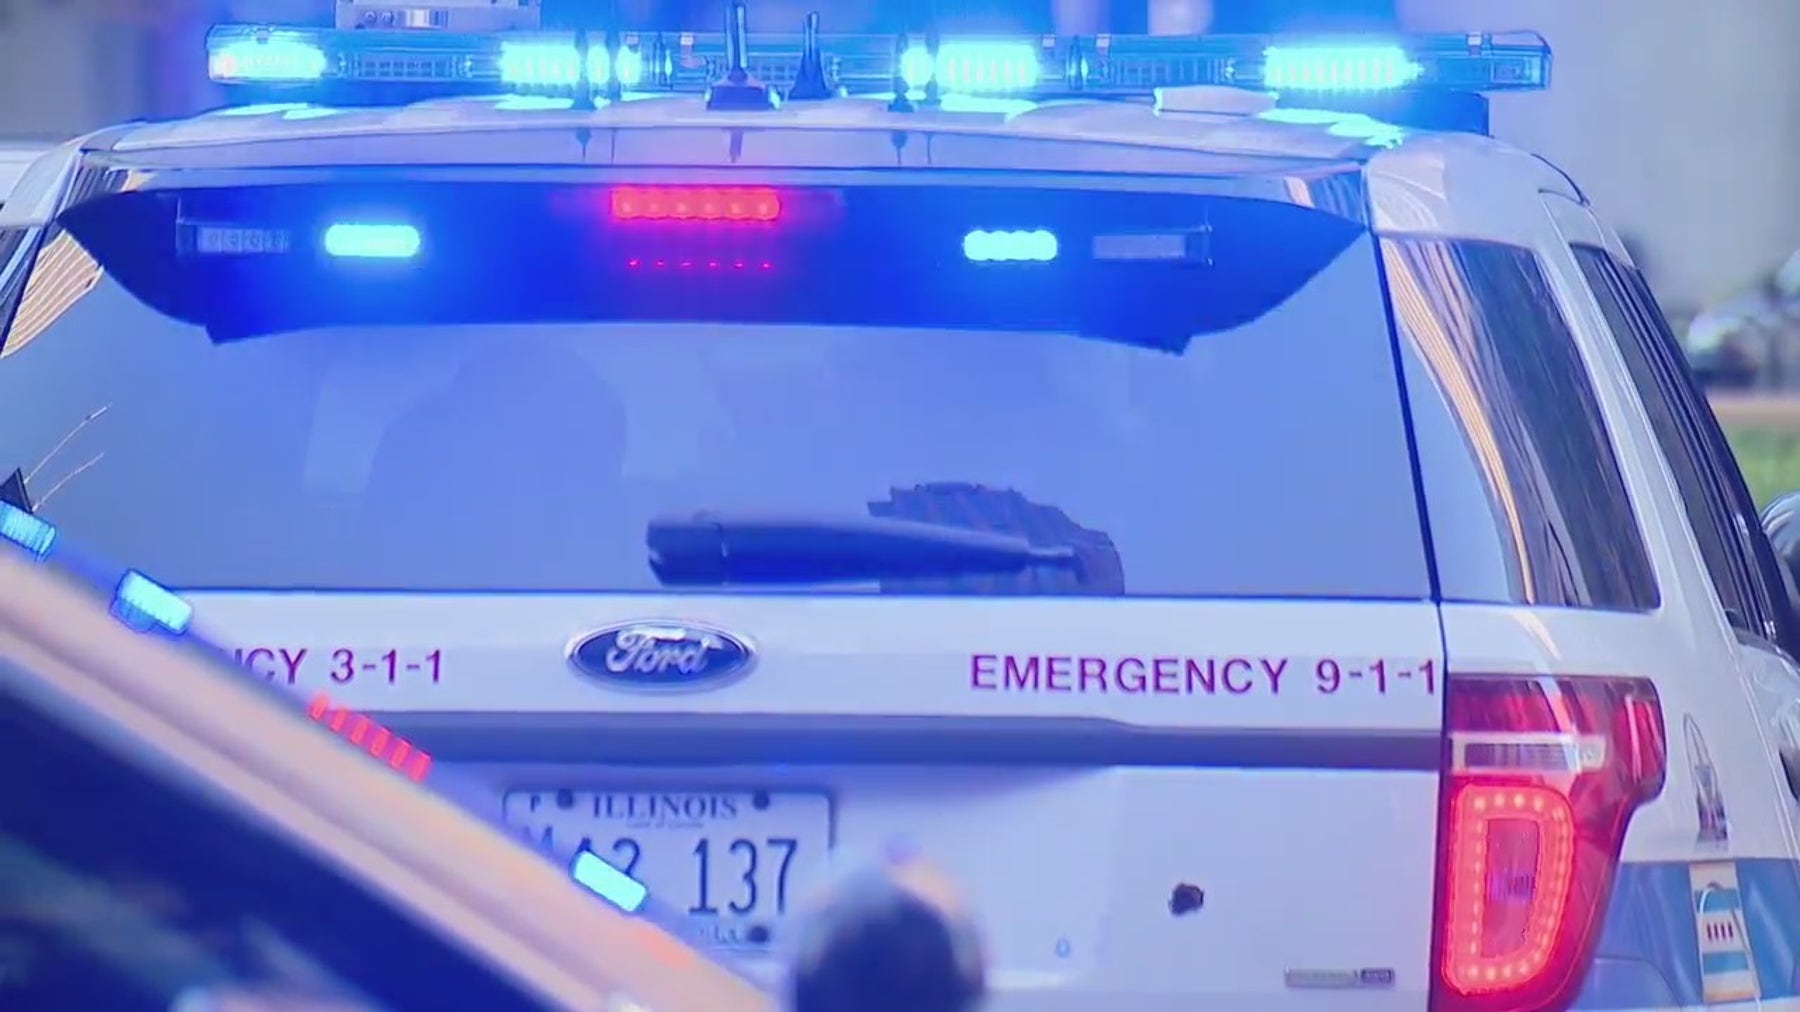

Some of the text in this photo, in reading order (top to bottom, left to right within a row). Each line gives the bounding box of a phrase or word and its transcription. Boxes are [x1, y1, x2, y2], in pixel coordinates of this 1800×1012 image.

[330, 648, 443, 684] 3-1-1
[606, 627, 723, 674] Ford
[969, 654, 1435, 695] EMERGENCY 9-1-1
[593, 795, 738, 819] ILLINOIS
[688, 838, 798, 917] 137
